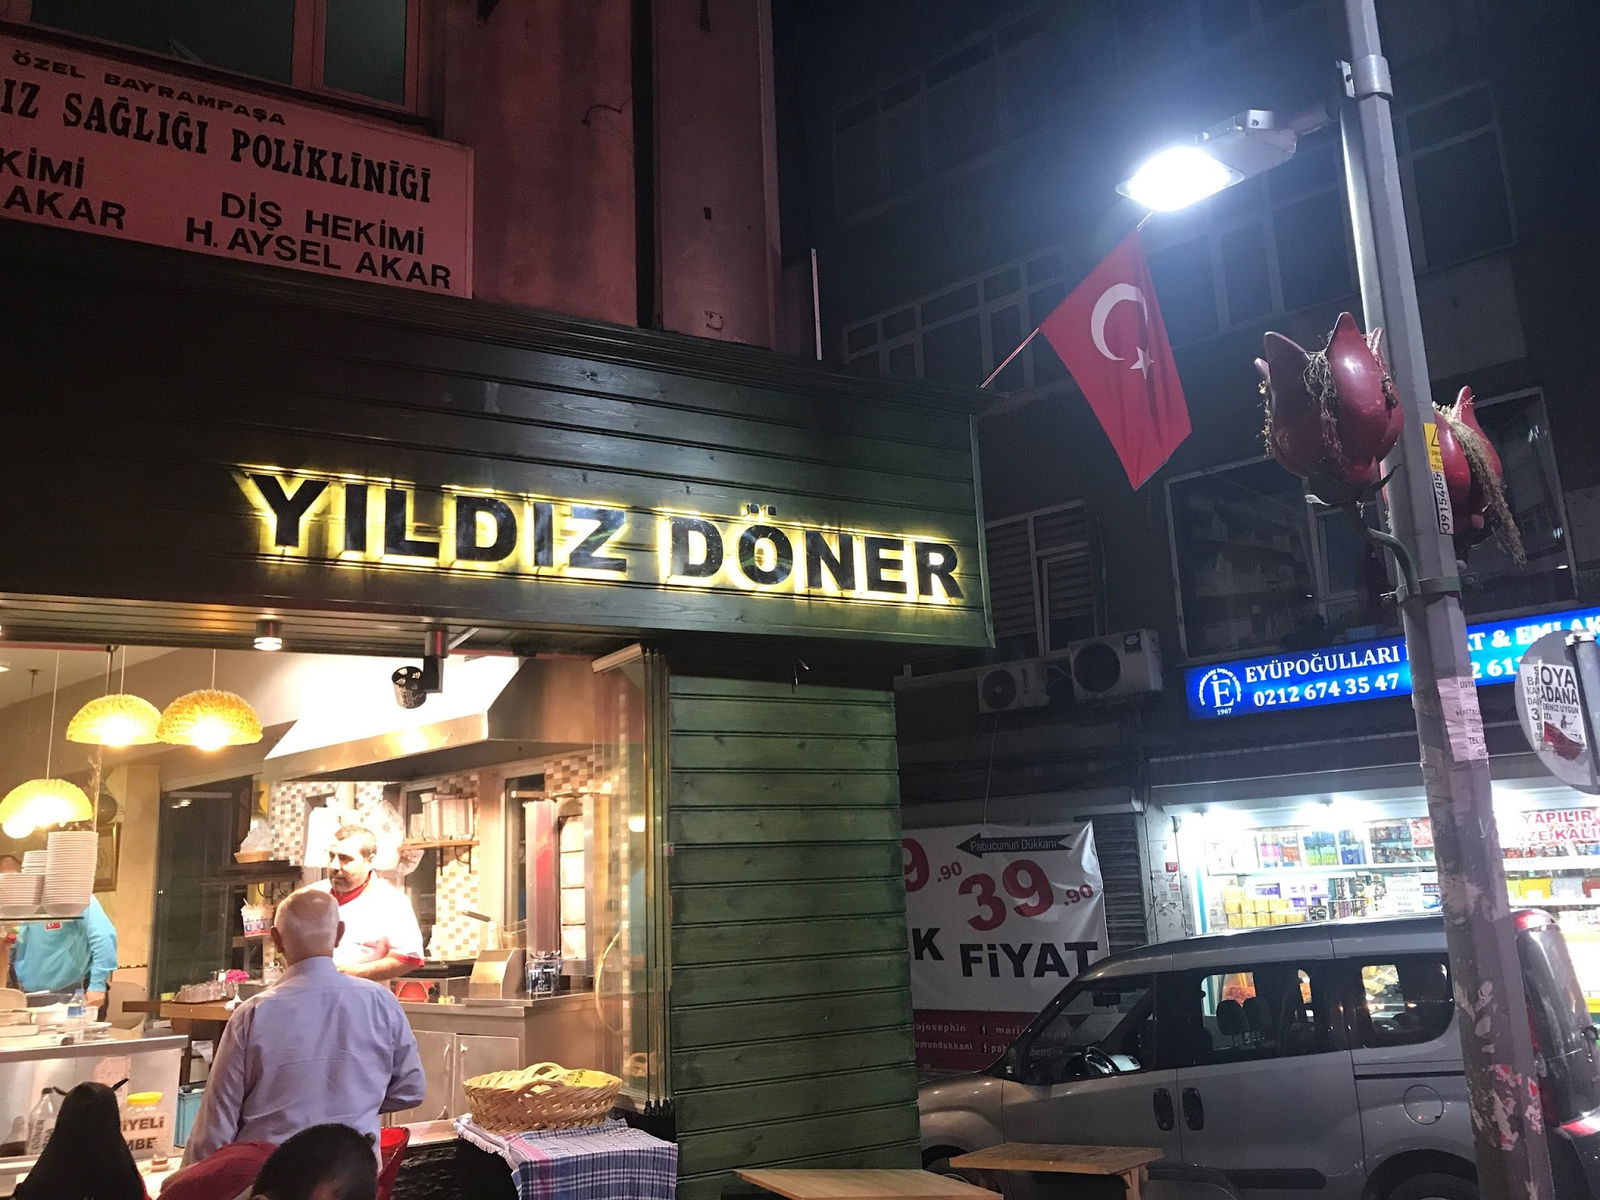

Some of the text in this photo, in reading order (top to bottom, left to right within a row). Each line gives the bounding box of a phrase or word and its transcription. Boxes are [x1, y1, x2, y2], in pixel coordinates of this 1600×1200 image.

[12, 50, 286, 125] ÖZEL BAYRAMPAŞA
[0, 147, 85, 189] KİMİ
[62, 92, 209, 155] SAĞLIĞI
[230, 128, 431, 203] POLİKLİNİĞİ
[3, 184, 127, 230] AKAR
[220, 191, 425, 255] DİŞ HEKİMİ
[226, 227, 342, 270] AYSEL
[355, 251, 450, 290] AKAR
[247, 473, 964, 599] YILDIZ DÖNER
[1244, 645, 1400, 683] EYÜPOĞULLARI
[1253, 685, 1300, 707] 0212
[1304, 680, 1341, 700] 674
[1346, 678, 1370, 695] 35
[1374, 672, 1399, 691] 47
[1521, 809, 1592, 825] YAPILIR
[958, 859, 1054, 931] 39
